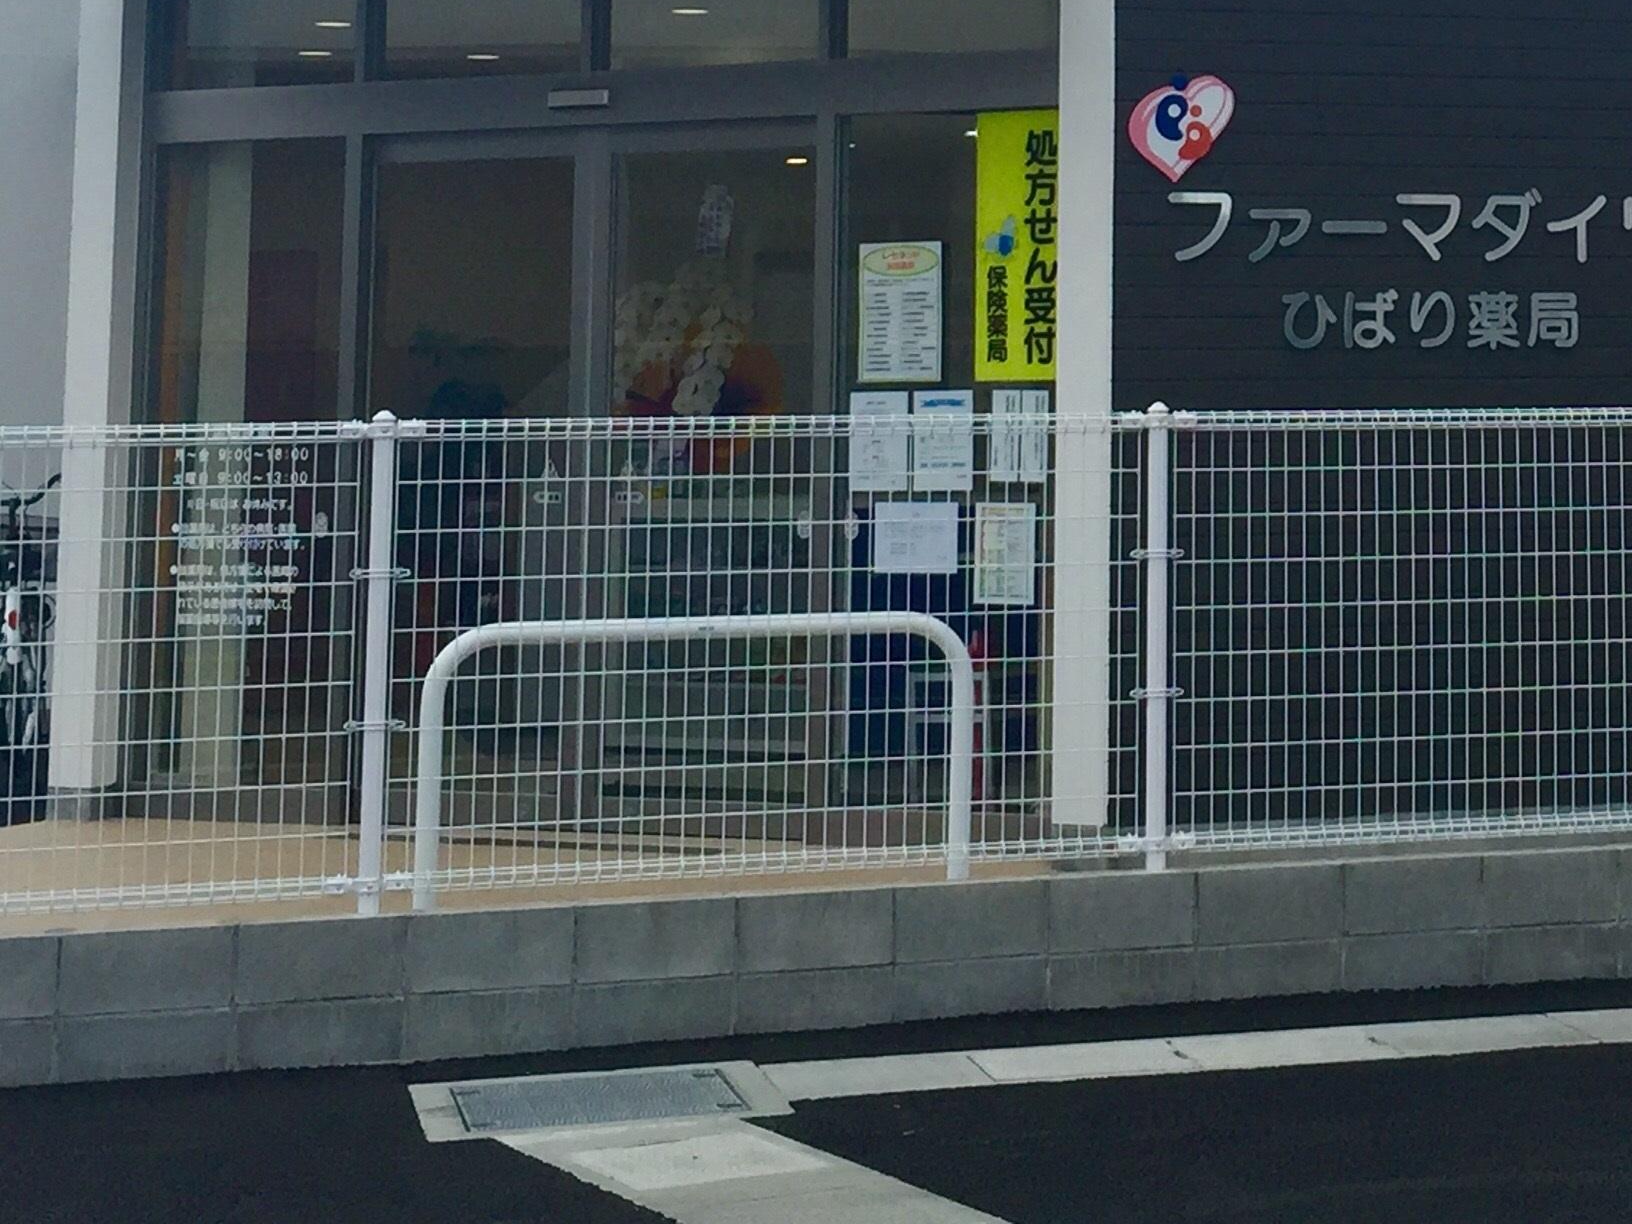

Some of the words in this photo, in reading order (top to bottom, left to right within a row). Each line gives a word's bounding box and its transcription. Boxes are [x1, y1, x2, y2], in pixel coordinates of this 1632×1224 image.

[1024, 129, 1057, 366] 処方せん受付
[987, 265, 1008, 363] 保険薬局
[1283, 289, 1580, 350] ひばり薬局
